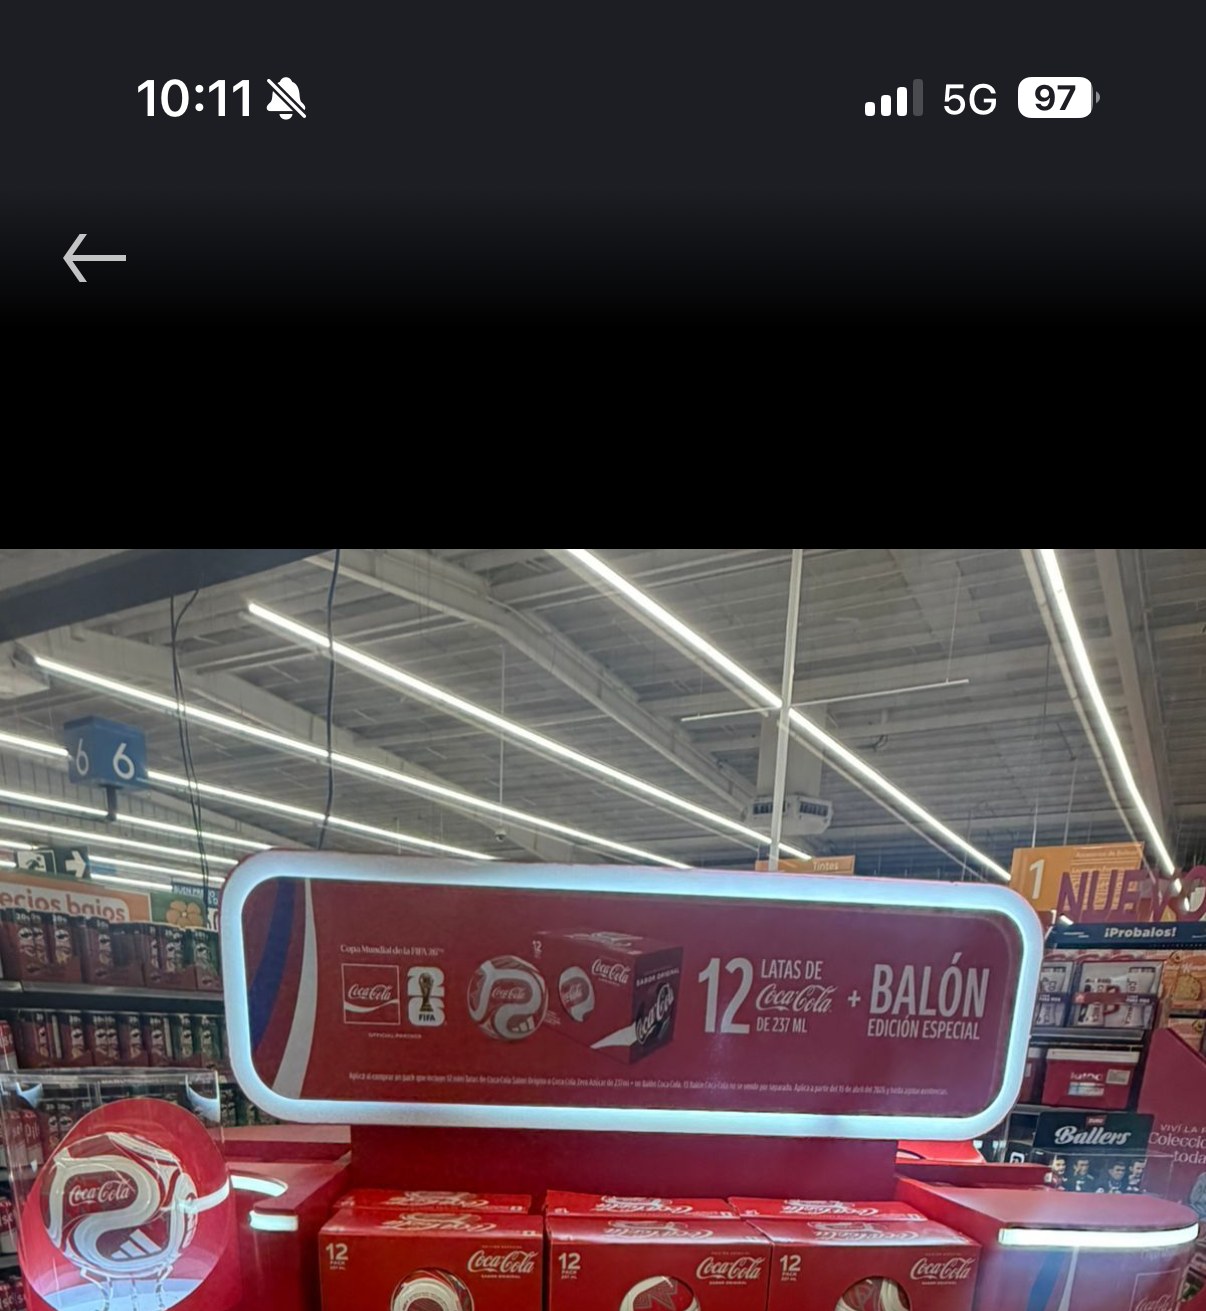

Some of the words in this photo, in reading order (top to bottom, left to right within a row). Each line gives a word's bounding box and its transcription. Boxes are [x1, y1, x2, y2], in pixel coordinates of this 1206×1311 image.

[76, 738, 89, 776] 6
[113, 743, 135, 780] 6
[1029, 859, 1045, 900] 1
[1104, 926, 1177, 938] ¡Probalos!
[340, 944, 360, 955] Copa
[361, 945, 391, 955] Mundial
[392, 946, 402, 955] de
[403, 946, 410, 955] la
[592, 958, 631, 984] Coca-Cola
[761, 959, 801, 980] LATAS
[804, 960, 823, 980] DE
[348, 983, 392, 1000] Coca-Cola
[698, 957, 754, 1034] 12
[869, 952, 989, 1018] BALÓN
[756, 983, 838, 1013] Coca-Cola
[635, 983, 674, 1045] Coca-Cola
[757, 1017, 771, 1032] DE
[772, 1017, 791, 1033] 237
[792, 1017, 807, 1033] ML
[867, 1015, 918, 1038] EDICIÓN
[922, 1020, 980, 1040] ESPECIAL
[1054, 1125, 1132, 1145] Ballers
[69, 1179, 130, 1206] Coca-Cola
[325, 1243, 348, 1260] 12
[467, 1249, 539, 1273] Coca-Cola
[558, 1252, 581, 1270] 12
[779, 1255, 801, 1271] 12
[696, 1256, 766, 1281] Coca-Cola
[909, 1257, 976, 1281] Coca-Cola
